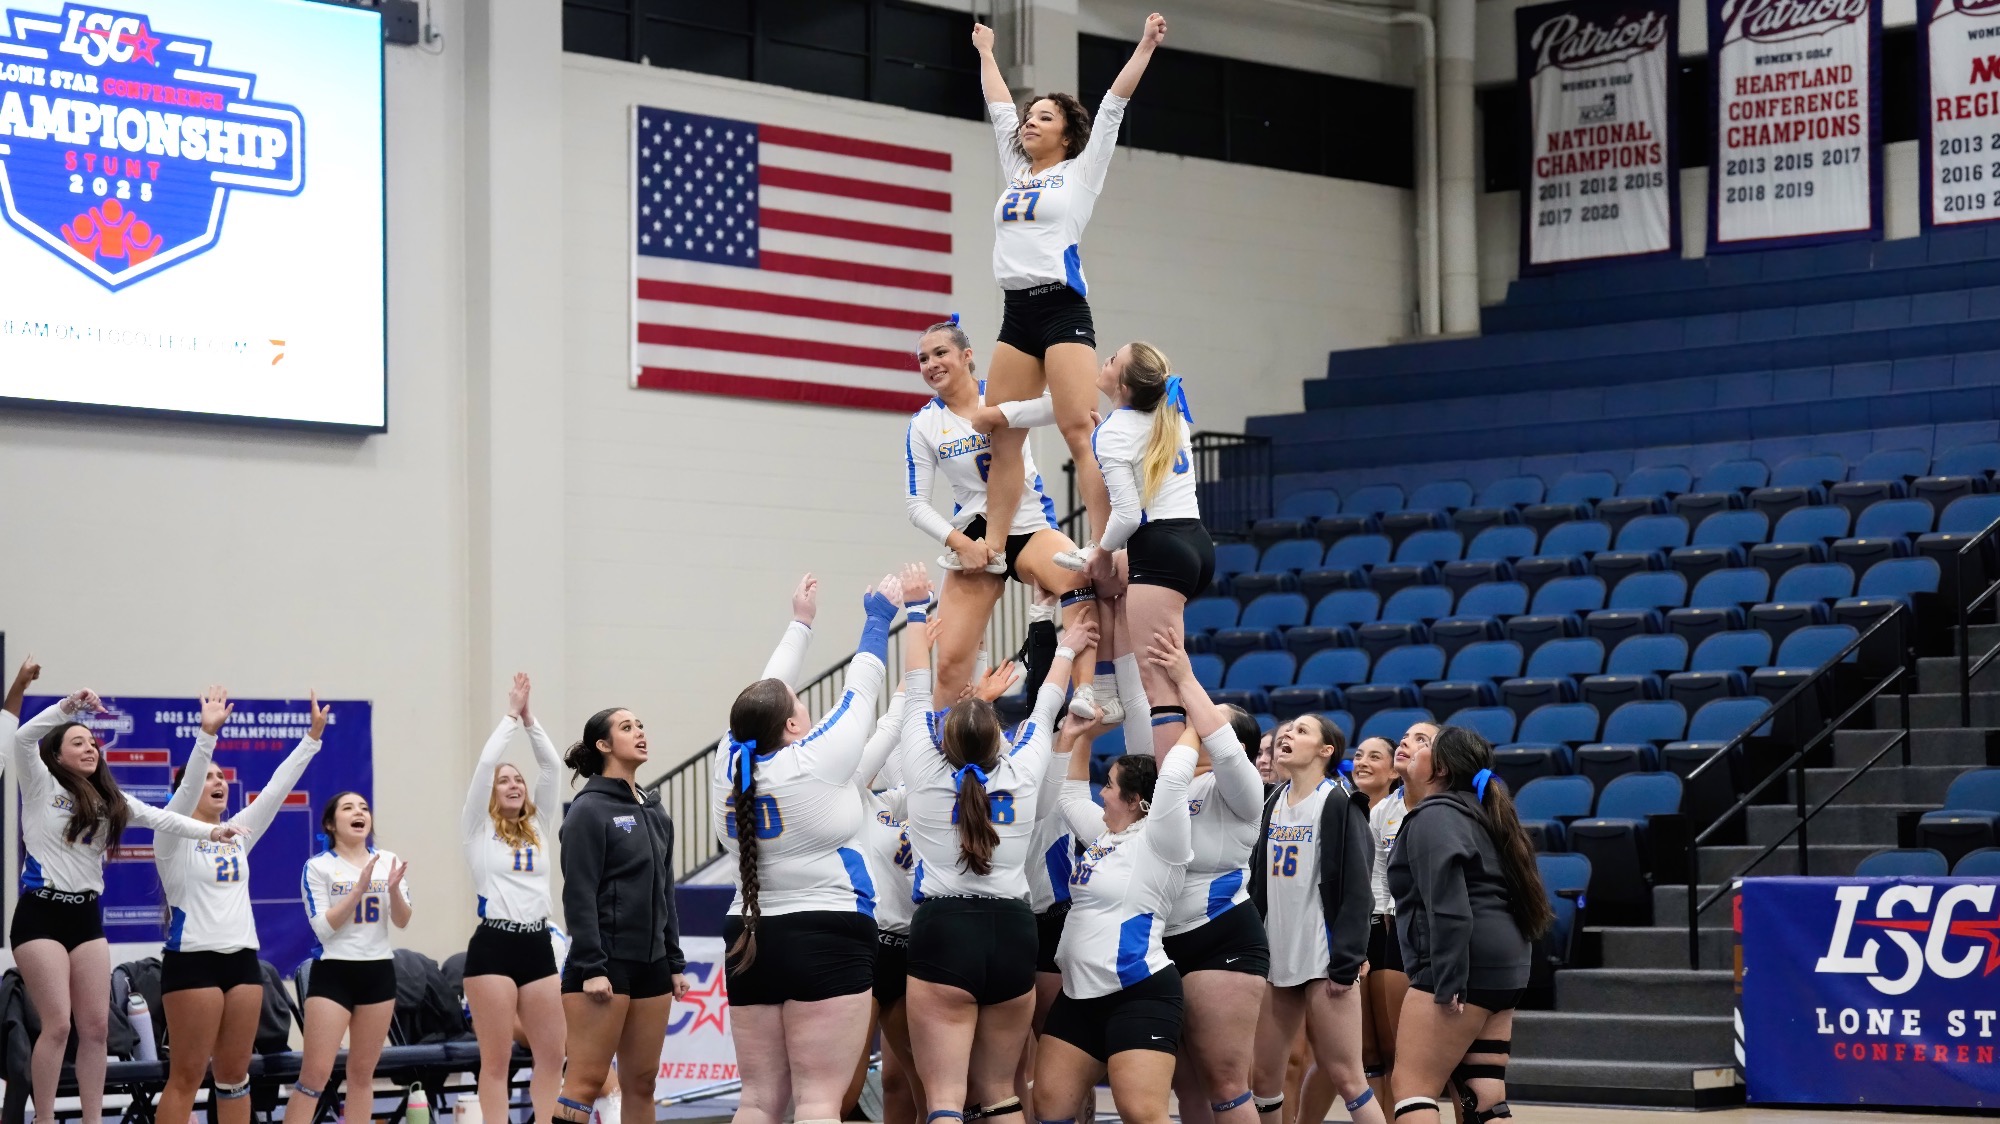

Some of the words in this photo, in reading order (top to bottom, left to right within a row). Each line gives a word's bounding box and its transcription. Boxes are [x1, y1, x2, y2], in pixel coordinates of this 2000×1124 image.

[59, 8, 141, 67] LSC
[1530, 10, 1668, 74] Patriots
[1755, 52, 1803, 66] WOMEN'S
[1806, 47, 1833, 60] GOLF
[49, 69, 99, 94] STAR
[103, 77, 225, 111] CONFERENCE
[1735, 65, 1853, 96] HEARTLAND
[1728, 89, 1859, 121] CONFERENCE
[1547, 121, 1652, 153] NATIONAL
[1727, 113, 1861, 148] CHAMPIONS
[1940, 135, 1983, 156] 2013
[64, 150, 160, 181] STUNT
[1537, 142, 1661, 179] CHAMPIONS
[1726, 157, 1766, 176] 2013
[1774, 152, 1814, 172] 2015
[1822, 147, 1861, 166] 2017
[1942, 164, 1983, 184] 2016
[68, 173, 153, 202] 2025
[1539, 181, 1571, 202] 2011
[1580, 176, 1618, 195] 2012
[1625, 172, 1663, 190] 2015
[1726, 185, 1766, 204] 2018
[1774, 181, 1814, 199] 2019
[1002, 190, 1041, 223] 27
[1539, 208, 1572, 227] 2017
[1581, 203, 1619, 222] 2020
[1944, 193, 1985, 212] 2019
[1029, 286, 1049, 297] NIKE
[154, 710, 184, 724] 2025
[187, 711, 202, 724] LO
[176, 725, 199, 738] STU
[215, 856, 240, 883] 21
[513, 848, 534, 872] 11
[1272, 844, 1299, 878] 26
[51, 892, 85, 904] PRO
[354, 895, 380, 924] 16
[484, 919, 518, 932] NIKE
[518, 920, 543, 933] PRO
[1814, 884, 1997, 996] LSC
[1815, 1007, 1922, 1036] LONE
[1947, 1009, 1997, 1038] ST
